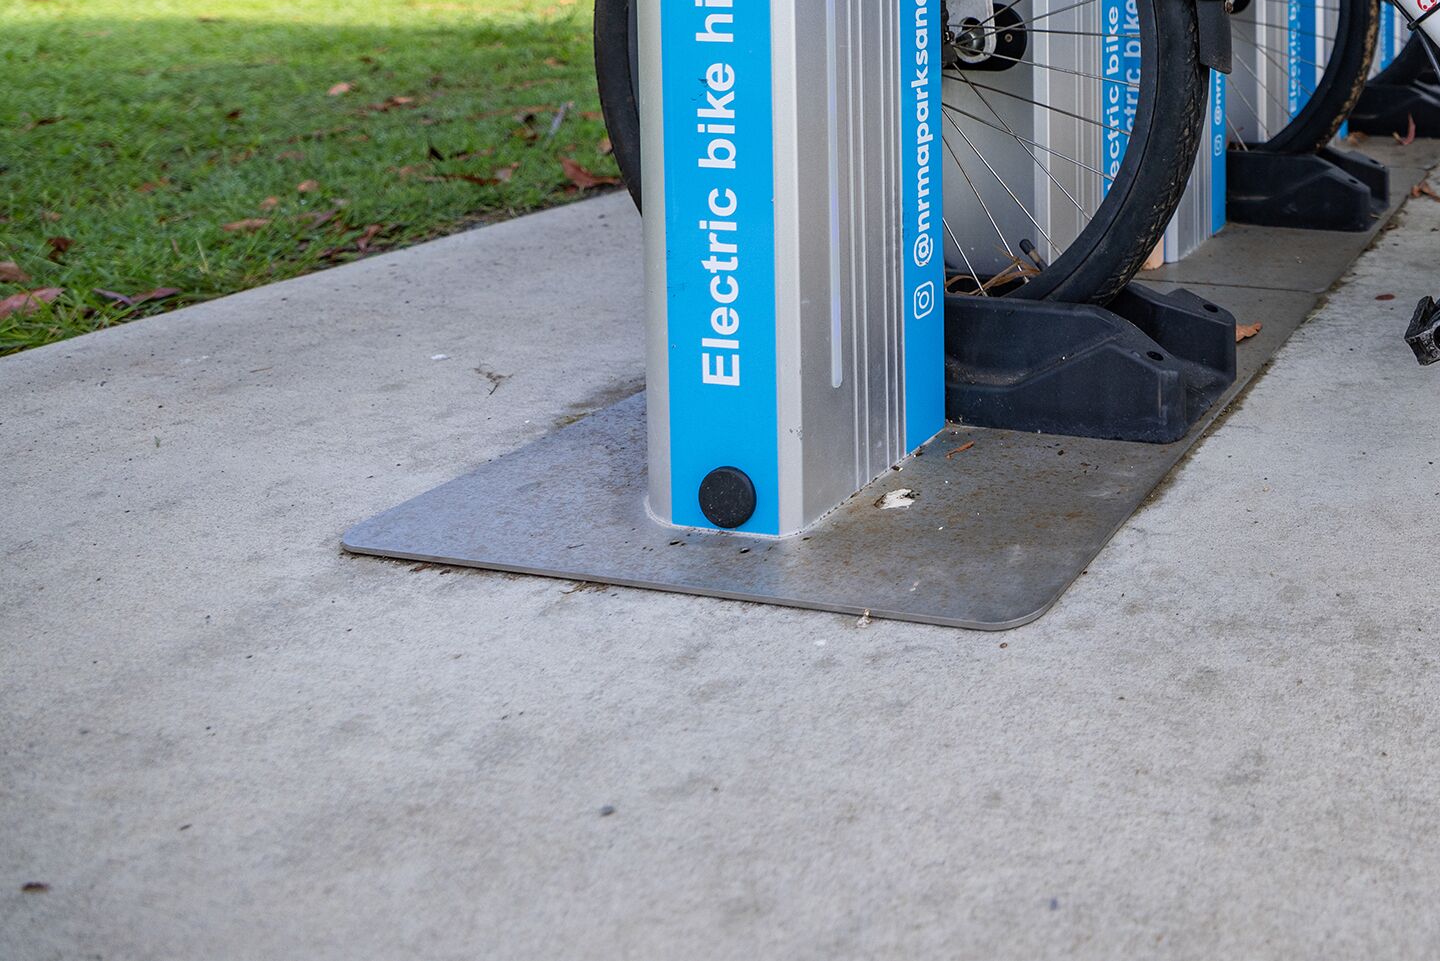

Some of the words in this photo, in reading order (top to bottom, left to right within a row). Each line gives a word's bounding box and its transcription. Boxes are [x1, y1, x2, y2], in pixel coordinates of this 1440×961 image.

[1106, 6, 1119, 76] bike
[697, 62, 737, 169] bike
[699, 187, 741, 387] Electric
